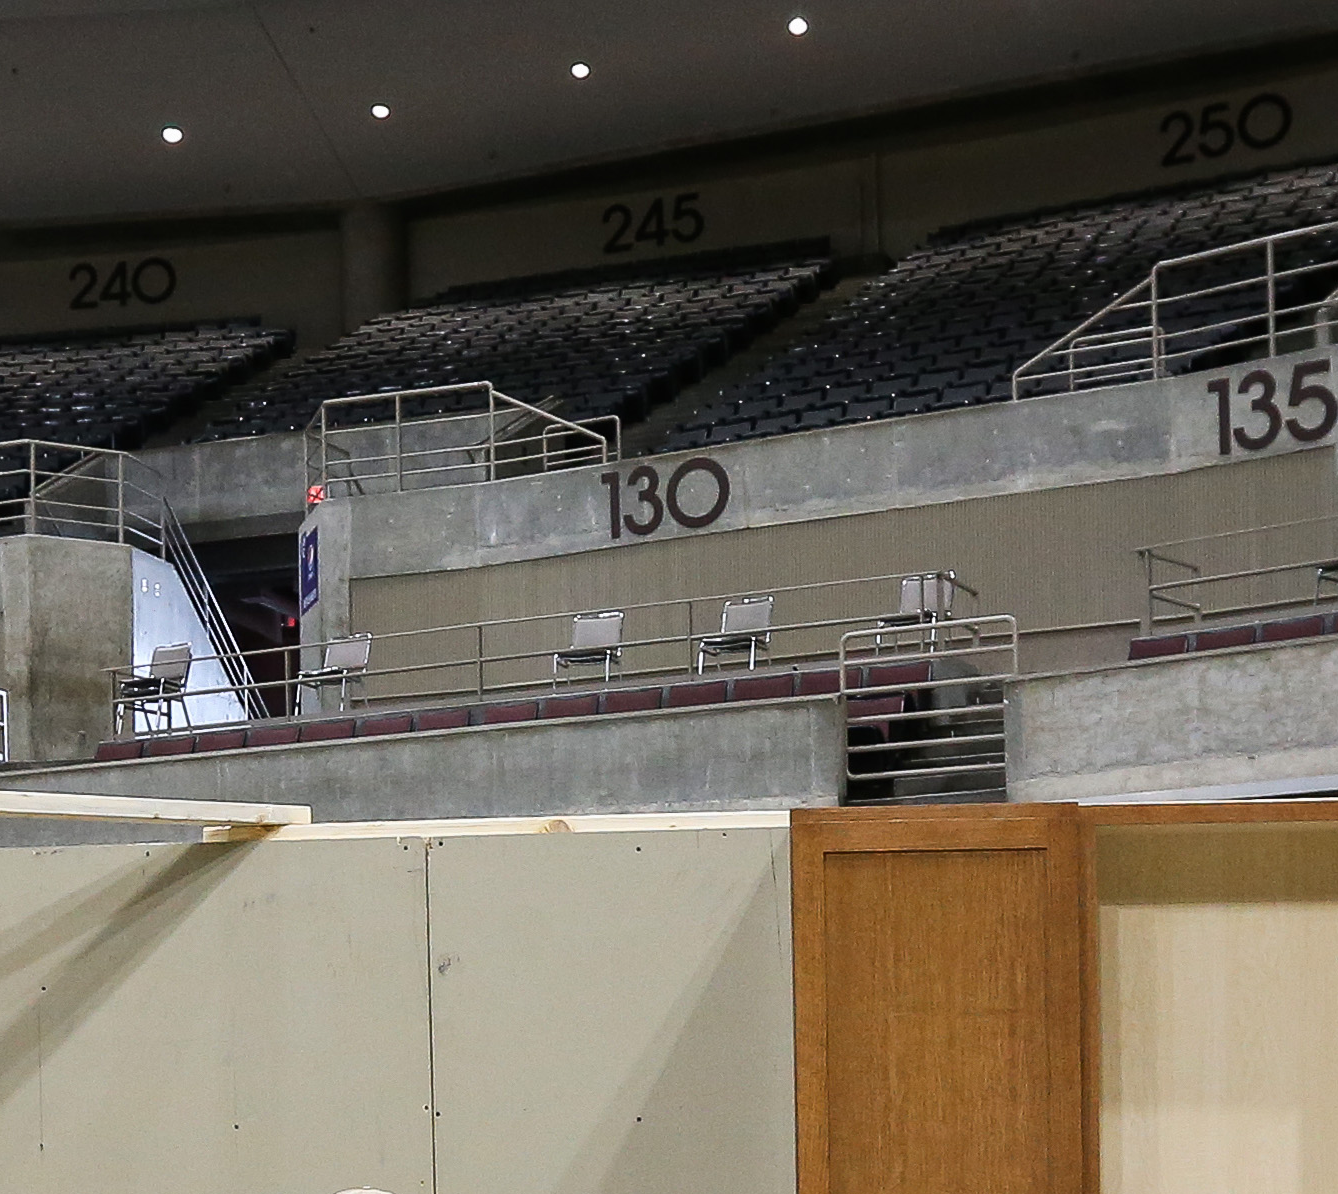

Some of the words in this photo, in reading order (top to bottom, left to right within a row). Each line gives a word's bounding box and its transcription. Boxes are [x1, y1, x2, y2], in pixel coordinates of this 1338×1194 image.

[1160, 93, 1292, 167] 250
[602, 192, 704, 254] 245
[69, 257, 176, 309] 240
[1207, 360, 1338, 455] 135
[601, 457, 730, 539] 130
